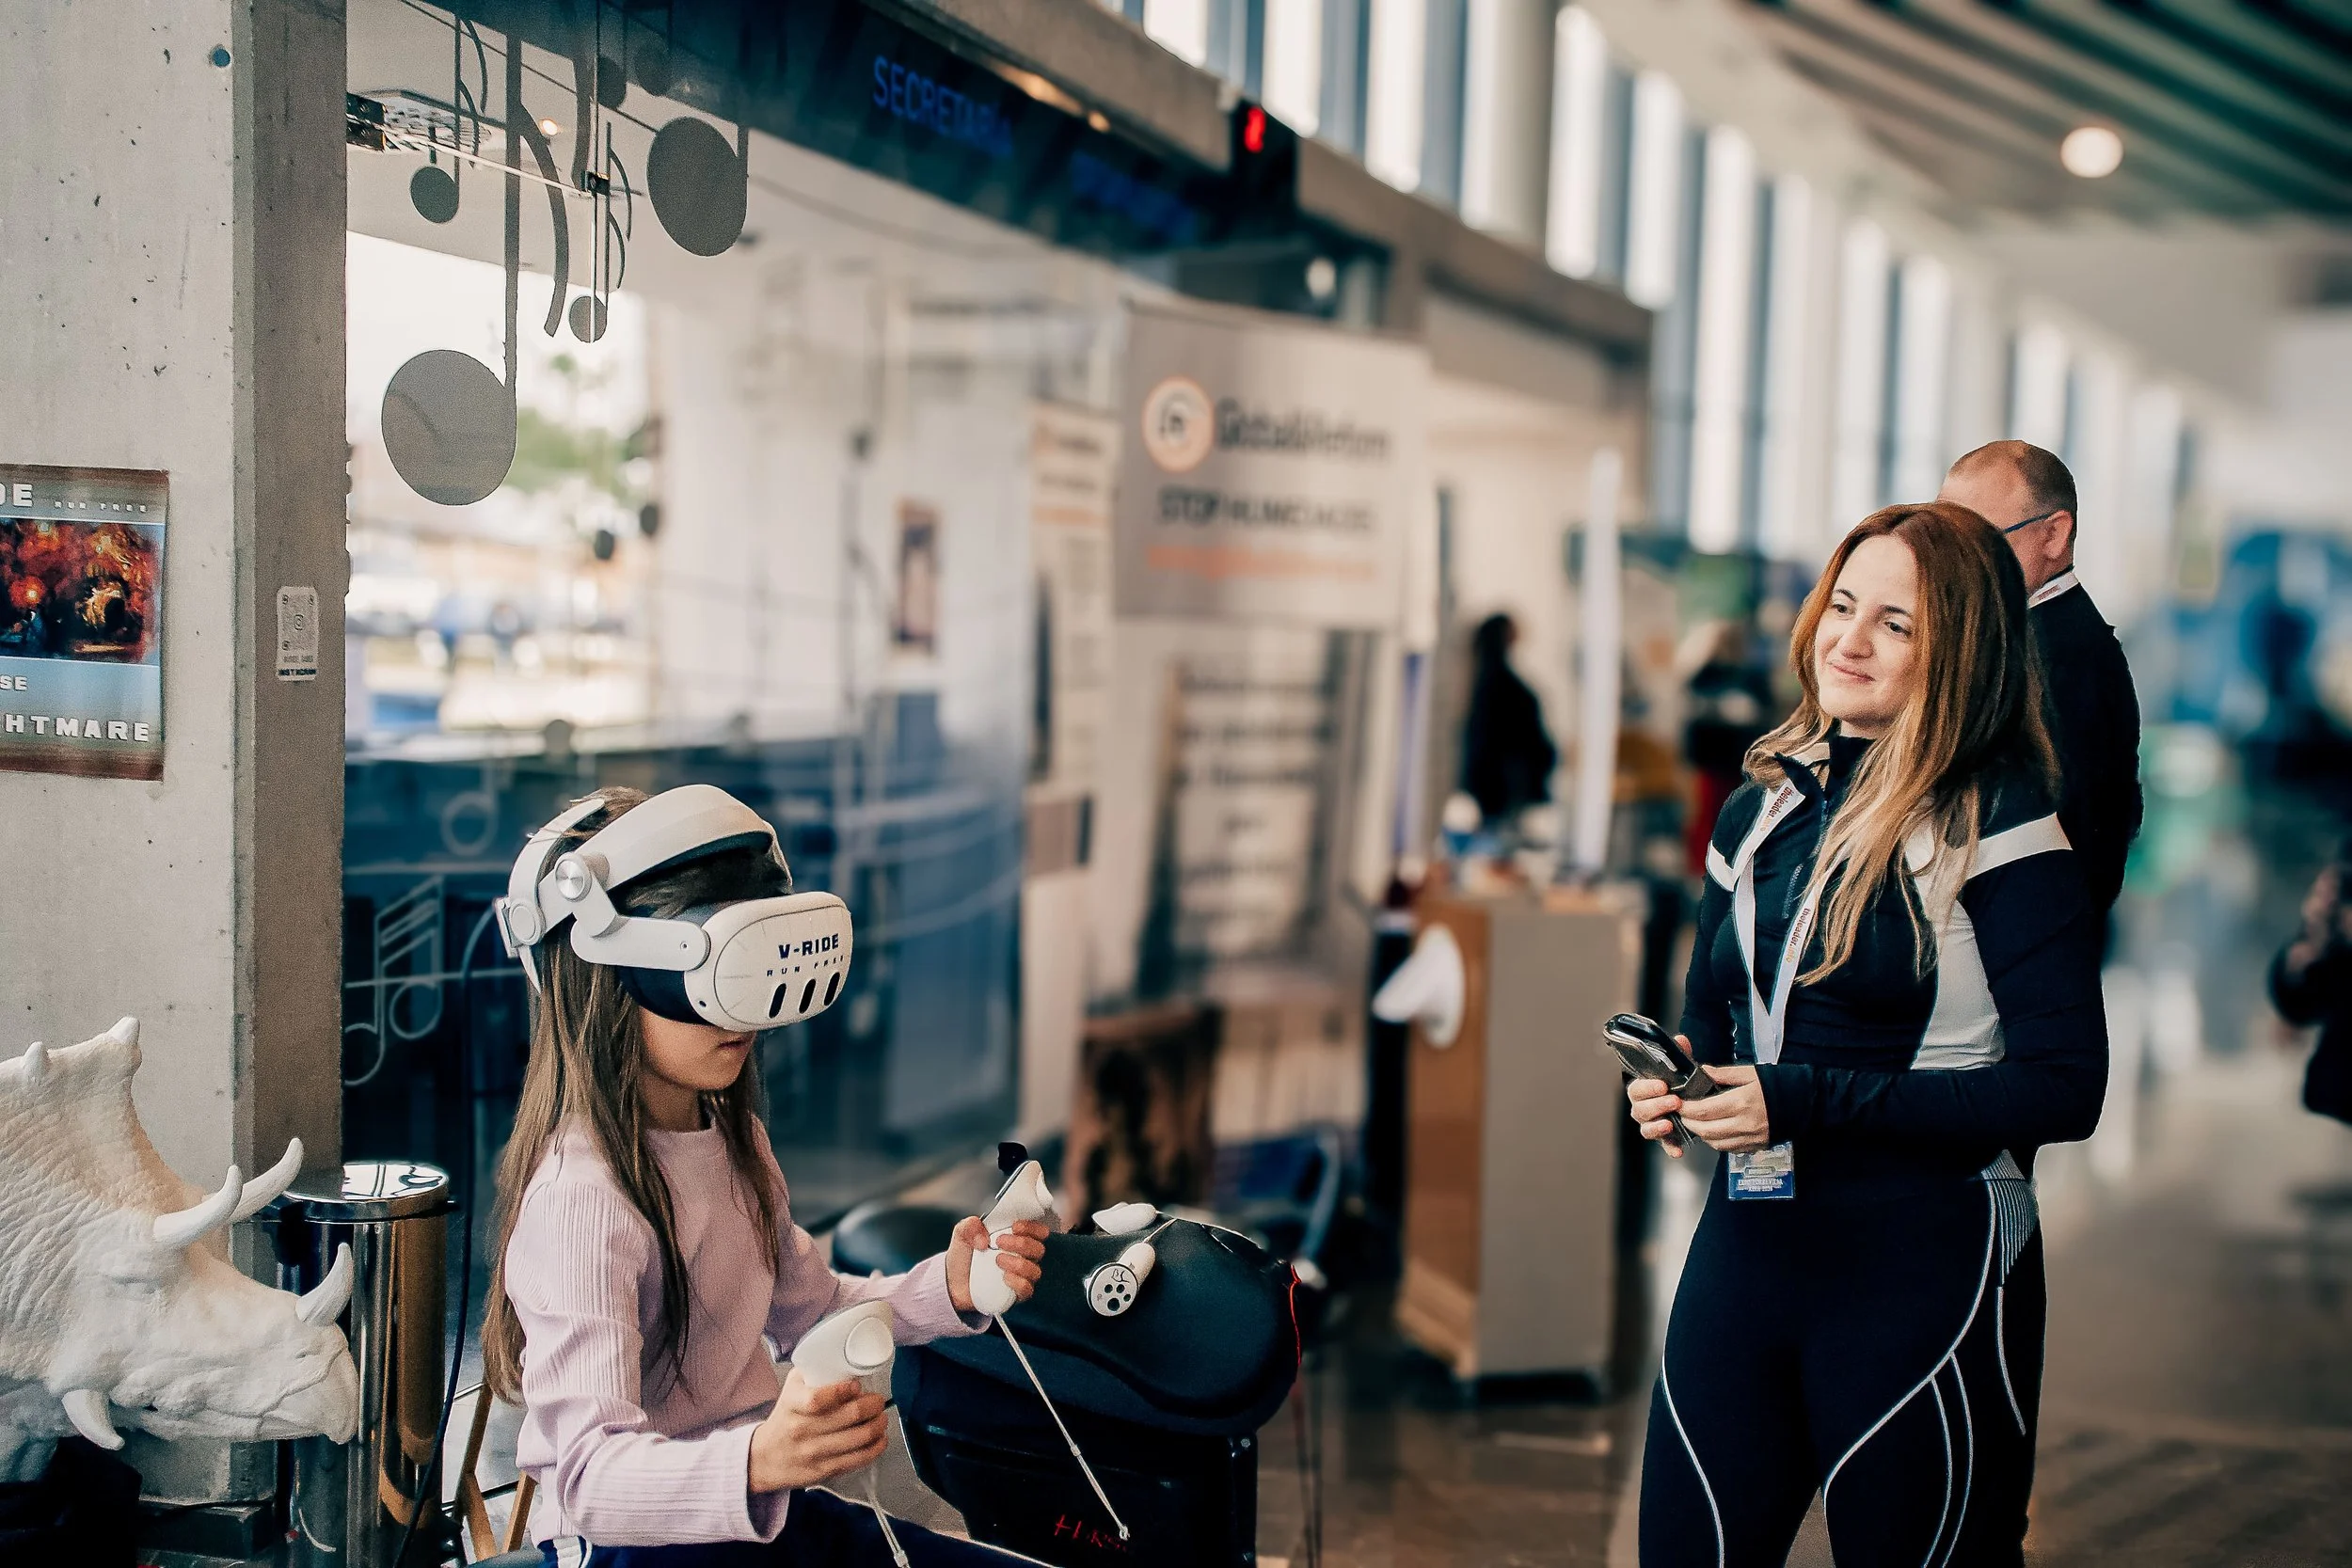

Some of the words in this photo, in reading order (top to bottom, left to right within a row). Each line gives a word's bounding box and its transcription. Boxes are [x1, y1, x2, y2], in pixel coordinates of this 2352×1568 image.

[100, 502, 148, 513] FREE
[0, 713, 150, 743] HTMARE
[778, 932, 839, 960] V-RIDE
[766, 965, 801, 977] RUN
